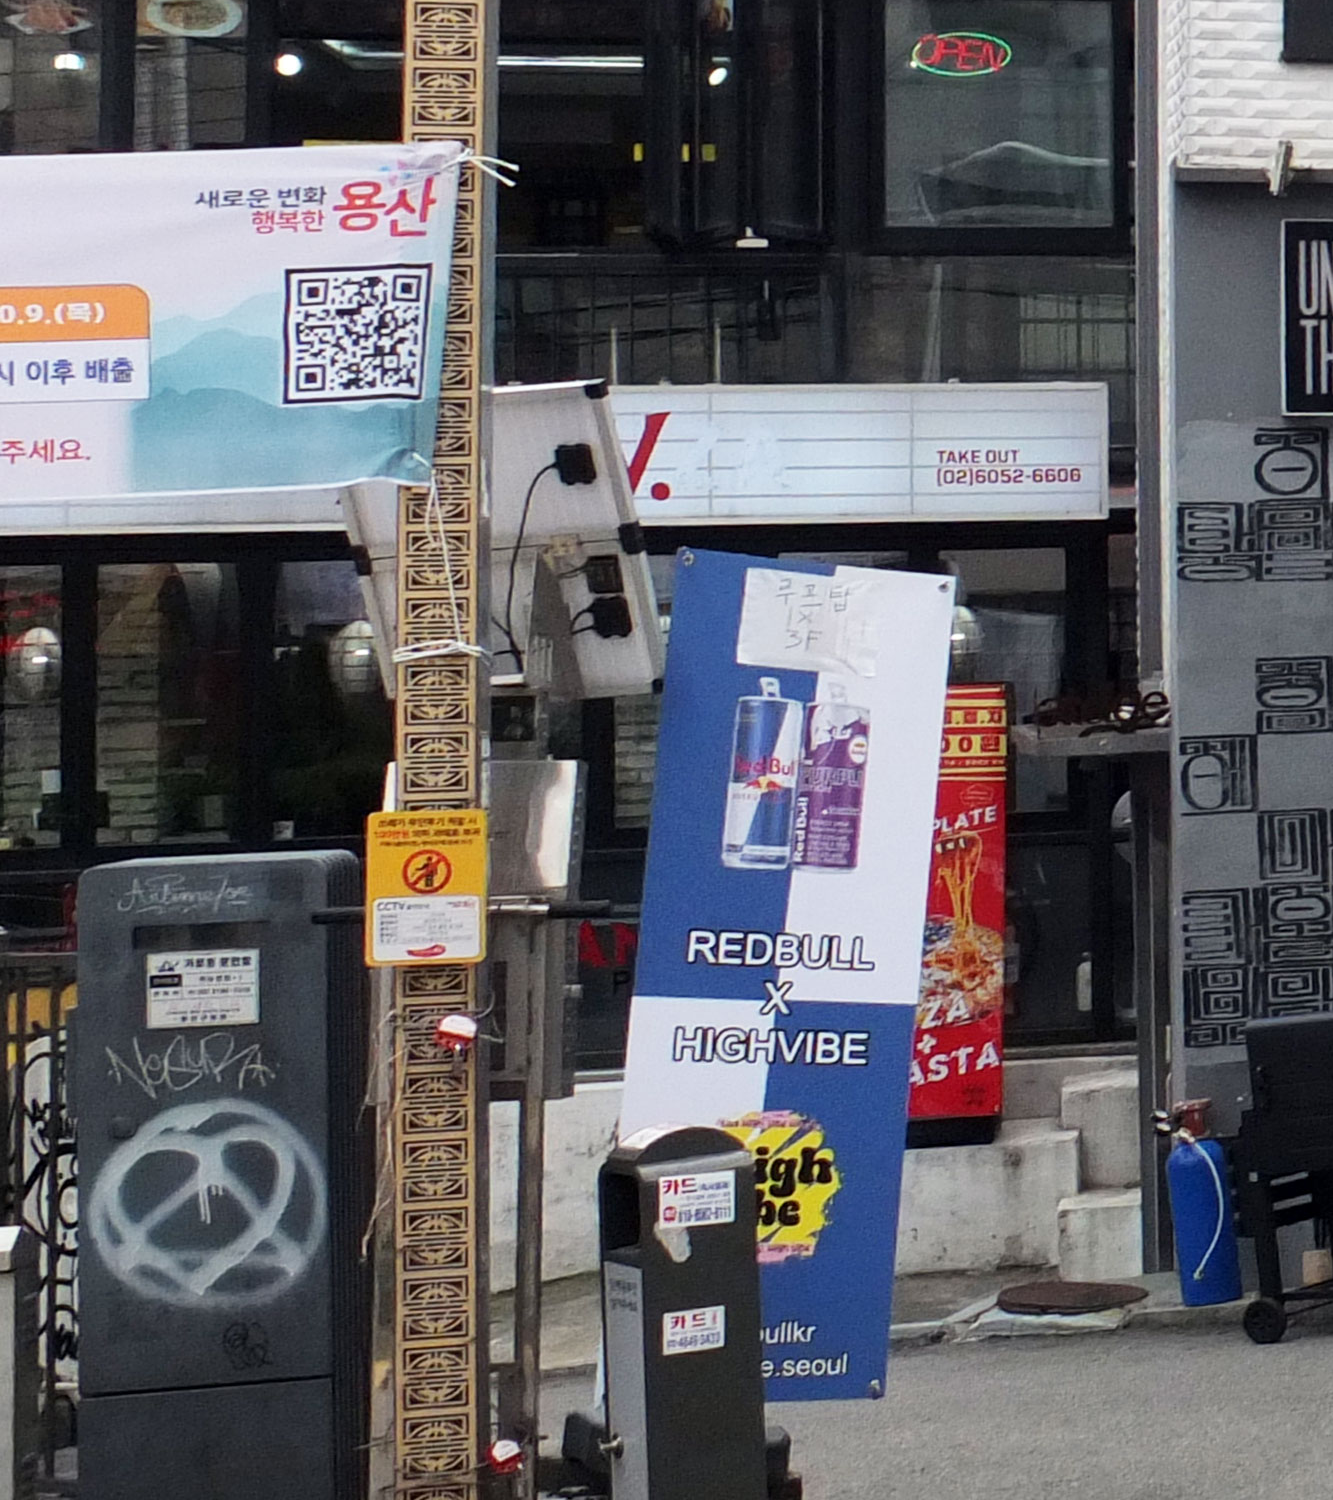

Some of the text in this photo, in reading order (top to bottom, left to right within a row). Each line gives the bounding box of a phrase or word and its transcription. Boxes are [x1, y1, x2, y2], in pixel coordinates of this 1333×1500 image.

[196, 186, 327, 209] 새로운 변화
[252, 179, 436, 237] 행복한 용산
[26, 359, 76, 385] 이후
[85, 357, 134, 383] 배출
[0, 438, 92, 465] 주세요.
[937, 448, 1020, 465] TAKE OUT
[686, 930, 875, 971] REDBULL
[760, 981, 793, 1016] X
[673, 1027, 871, 1066] HIGHVIBE
[909, 1041, 1000, 1086] ASTA
[662, 1177, 698, 1196] 카드
[755, 1147, 833, 1198] igh
[760, 1320, 817, 1345] ullkr
[760, 1353, 849, 1377] e.seoul
